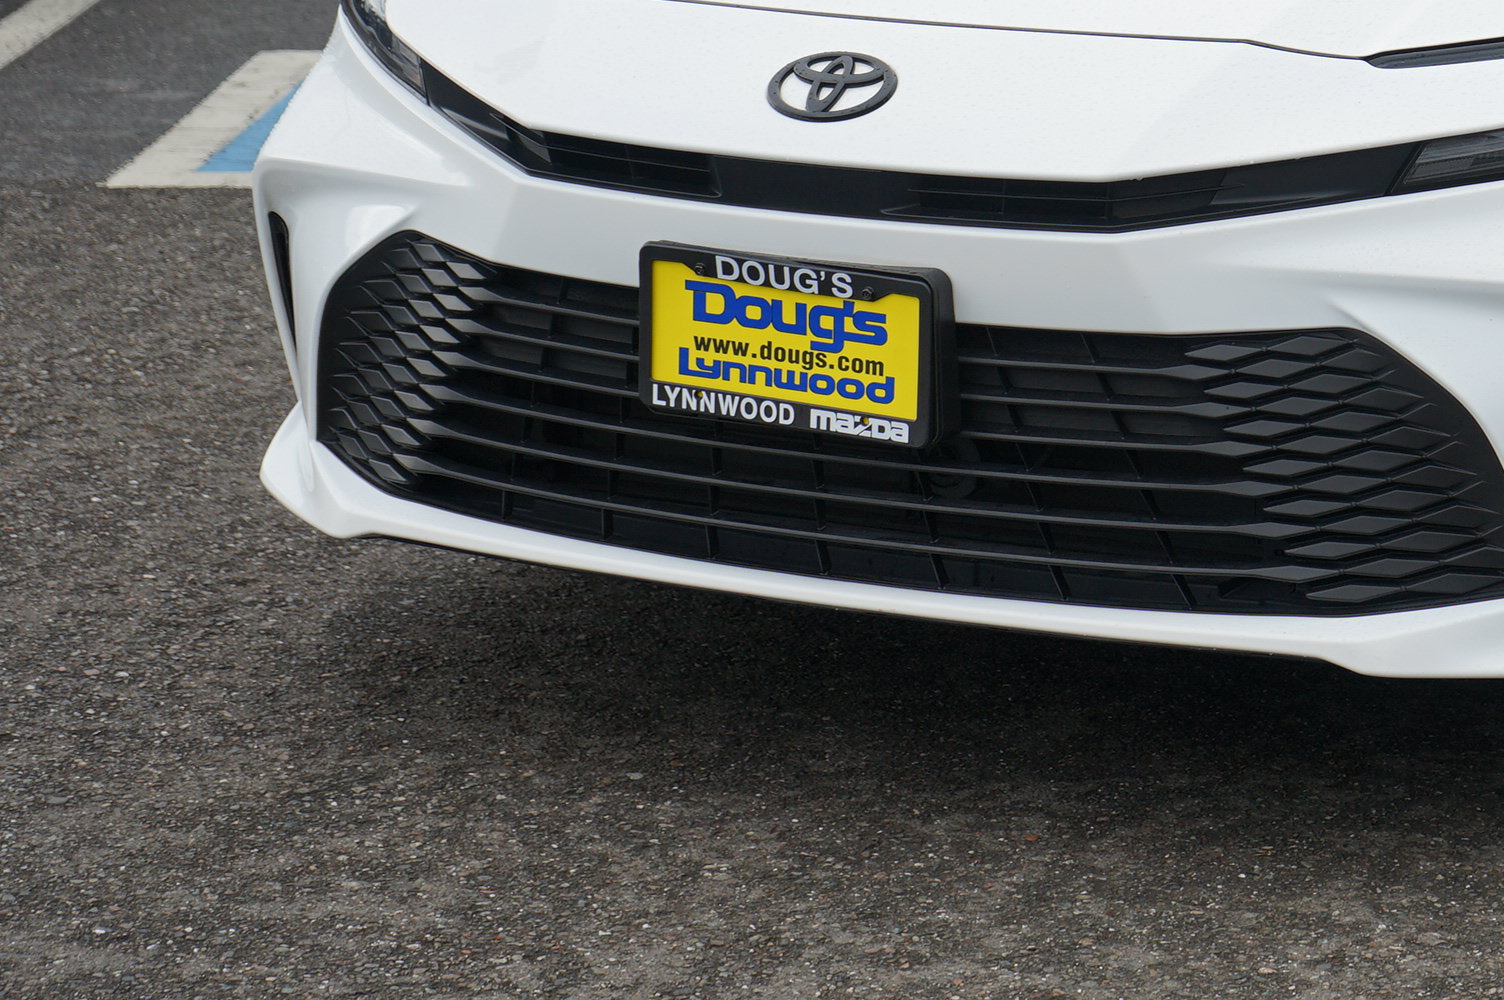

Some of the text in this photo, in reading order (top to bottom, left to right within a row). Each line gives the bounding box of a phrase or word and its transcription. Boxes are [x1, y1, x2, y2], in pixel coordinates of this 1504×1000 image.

[715, 255, 853, 298] DOUG'S
[684, 279, 888, 354] Doug's
[678, 347, 895, 404] Lynnwood
[693, 335, 885, 377] www.dougs.com
[652, 383, 795, 425] LYNNWOOD
